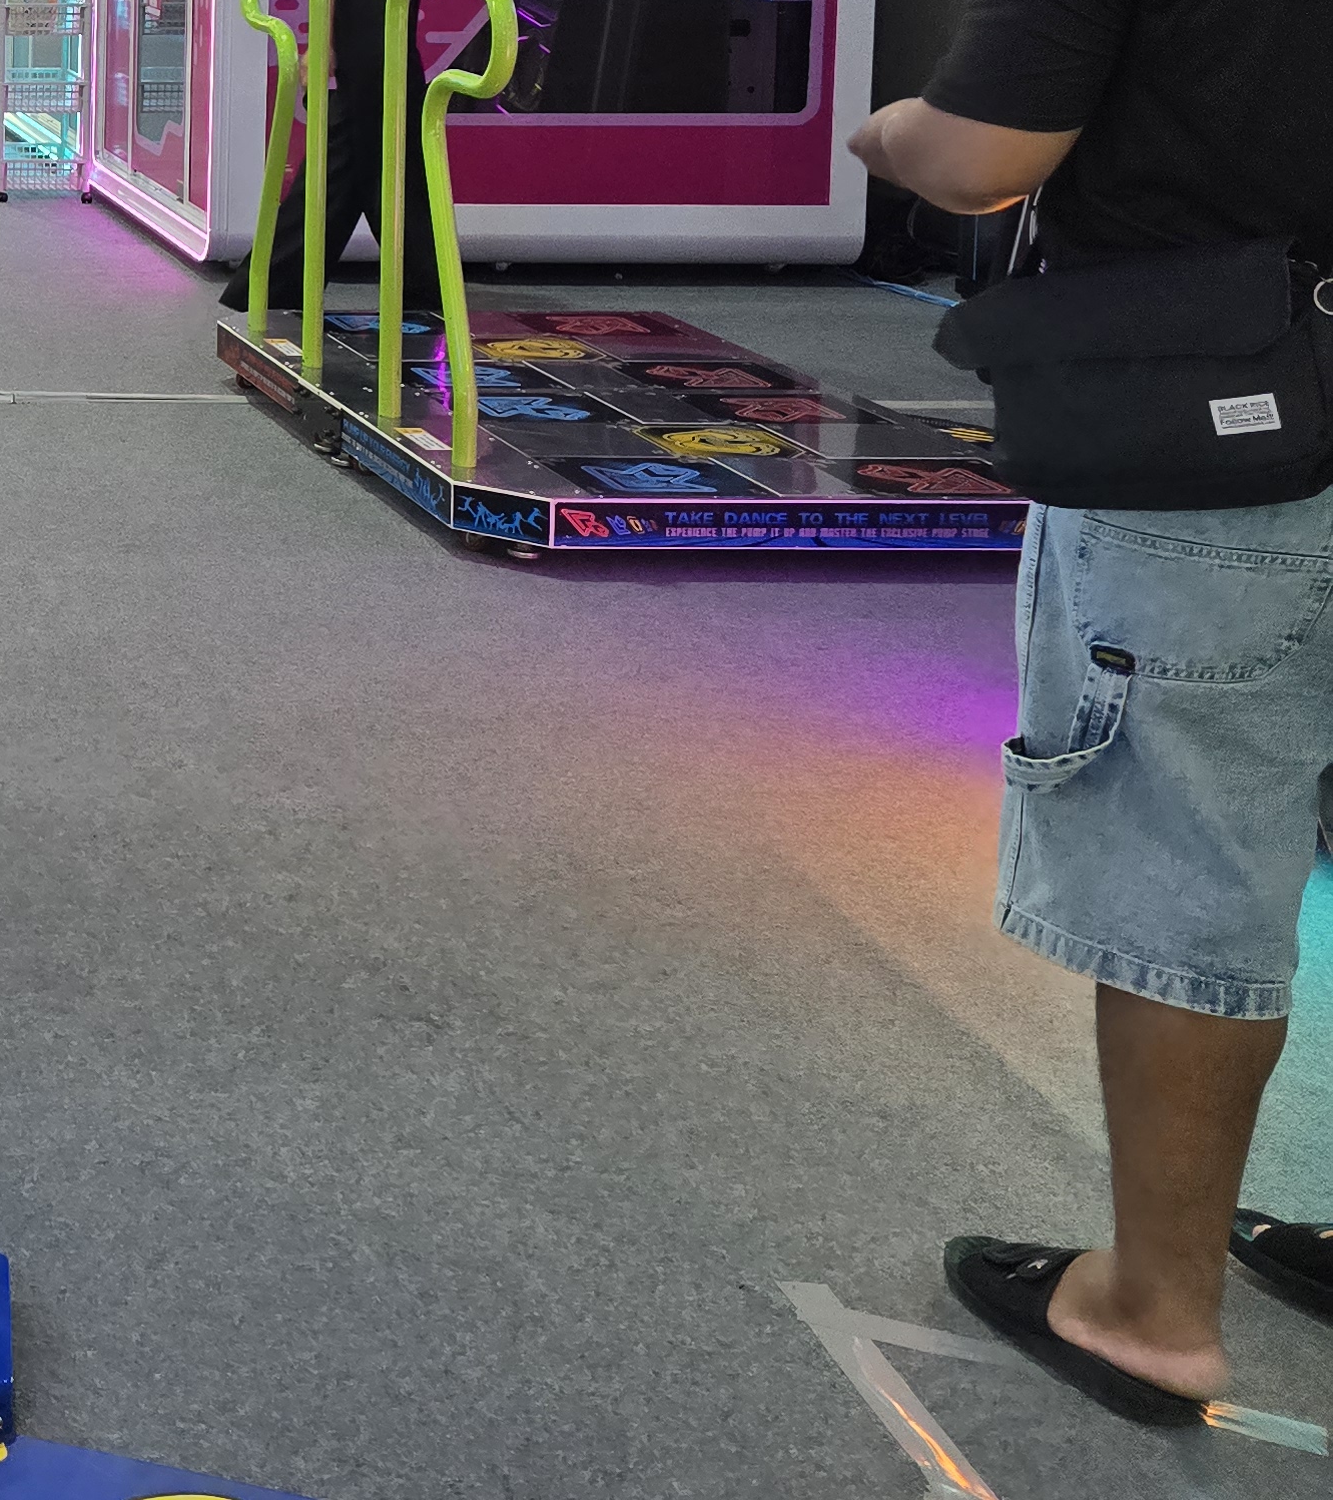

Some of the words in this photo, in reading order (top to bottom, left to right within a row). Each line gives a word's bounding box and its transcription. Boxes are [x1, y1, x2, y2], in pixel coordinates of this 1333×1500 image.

[664, 511, 714, 525] TAKE
[724, 511, 788, 525] DANCE
[798, 512, 823, 525] TO
[835, 512, 869, 525] THE
[879, 512, 930, 525] NEXT
[939, 513, 989, 526] LEVEL
[665, 527, 718, 538] EXPERIENCE
[722, 527, 738, 538] THE
[742, 527, 767, 538] PUMP
[770, 527, 780, 538] IT
